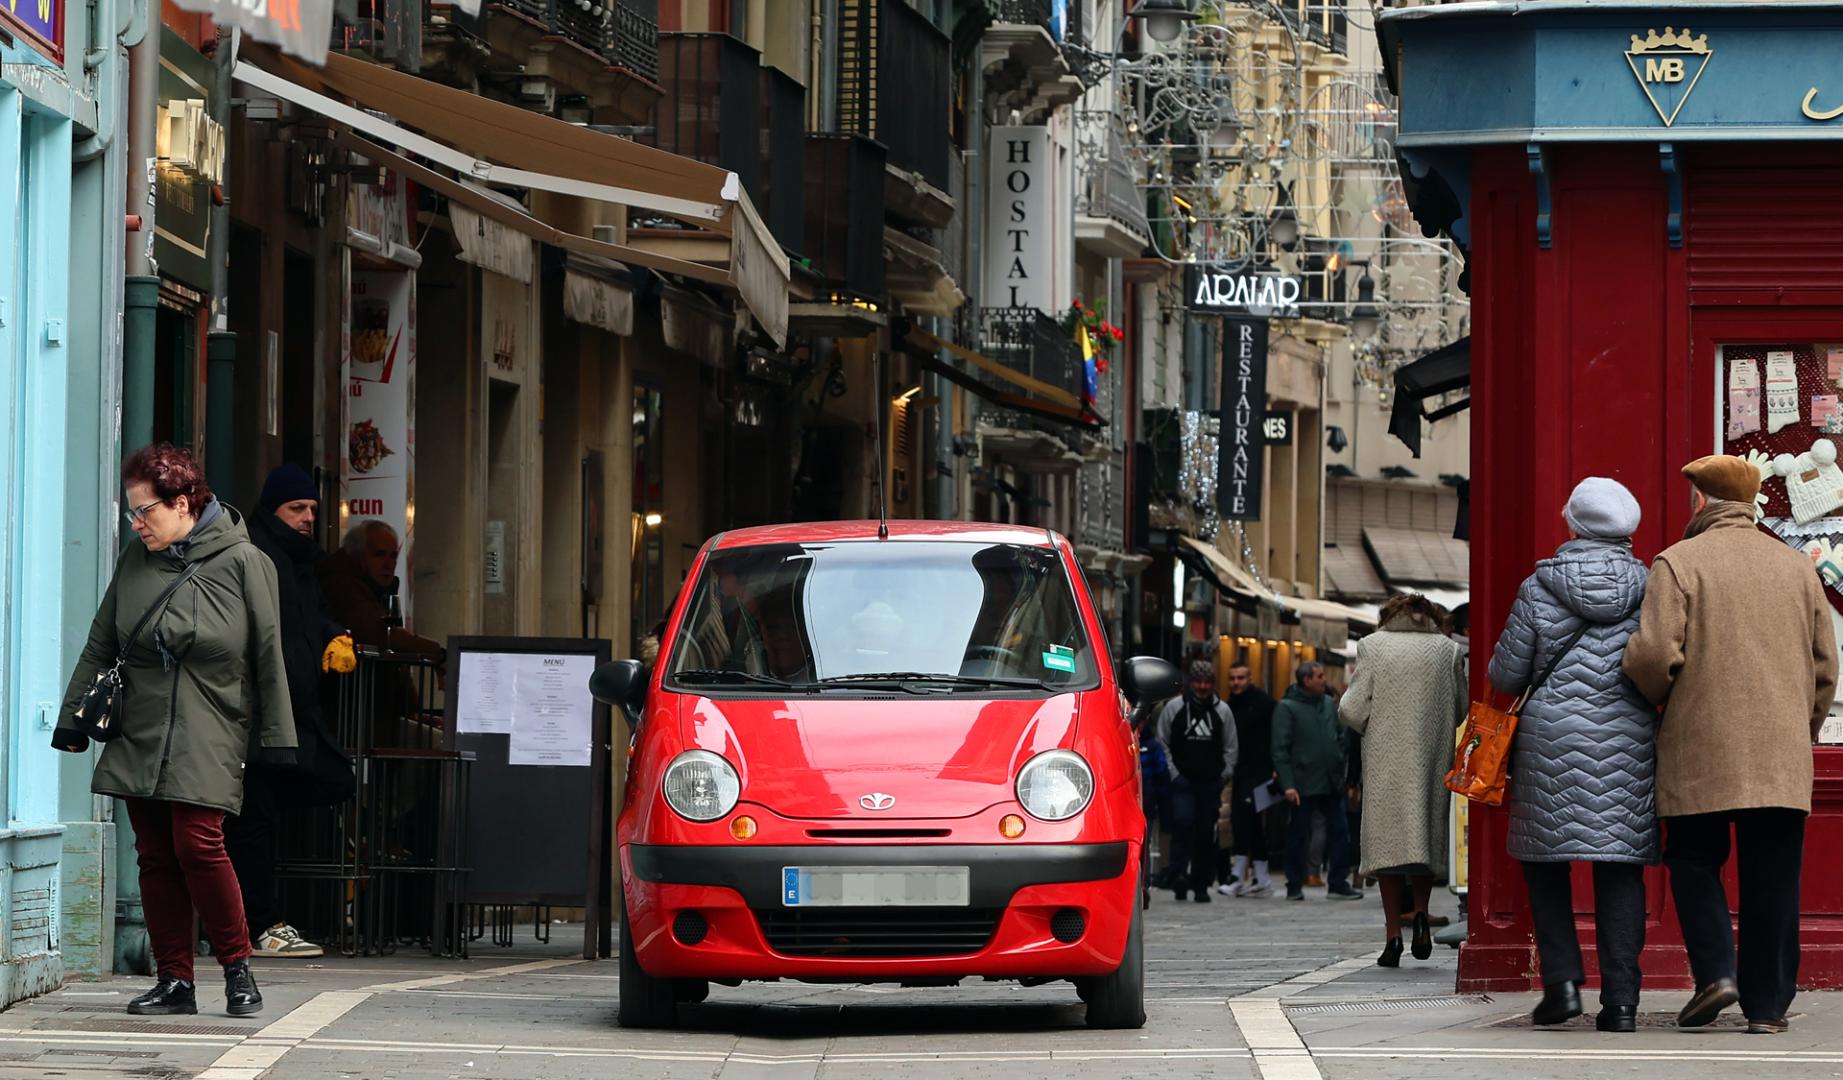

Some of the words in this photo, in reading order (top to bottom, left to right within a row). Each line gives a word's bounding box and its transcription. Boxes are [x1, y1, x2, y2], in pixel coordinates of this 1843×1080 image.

[1646, 58, 1685, 82] MB
[1006, 140, 1031, 308] HOSTAL
[1195, 274, 1300, 308] ARALAR
[1232, 324, 1253, 514] RESTAURANTE
[788, 890, 796, 899] E
